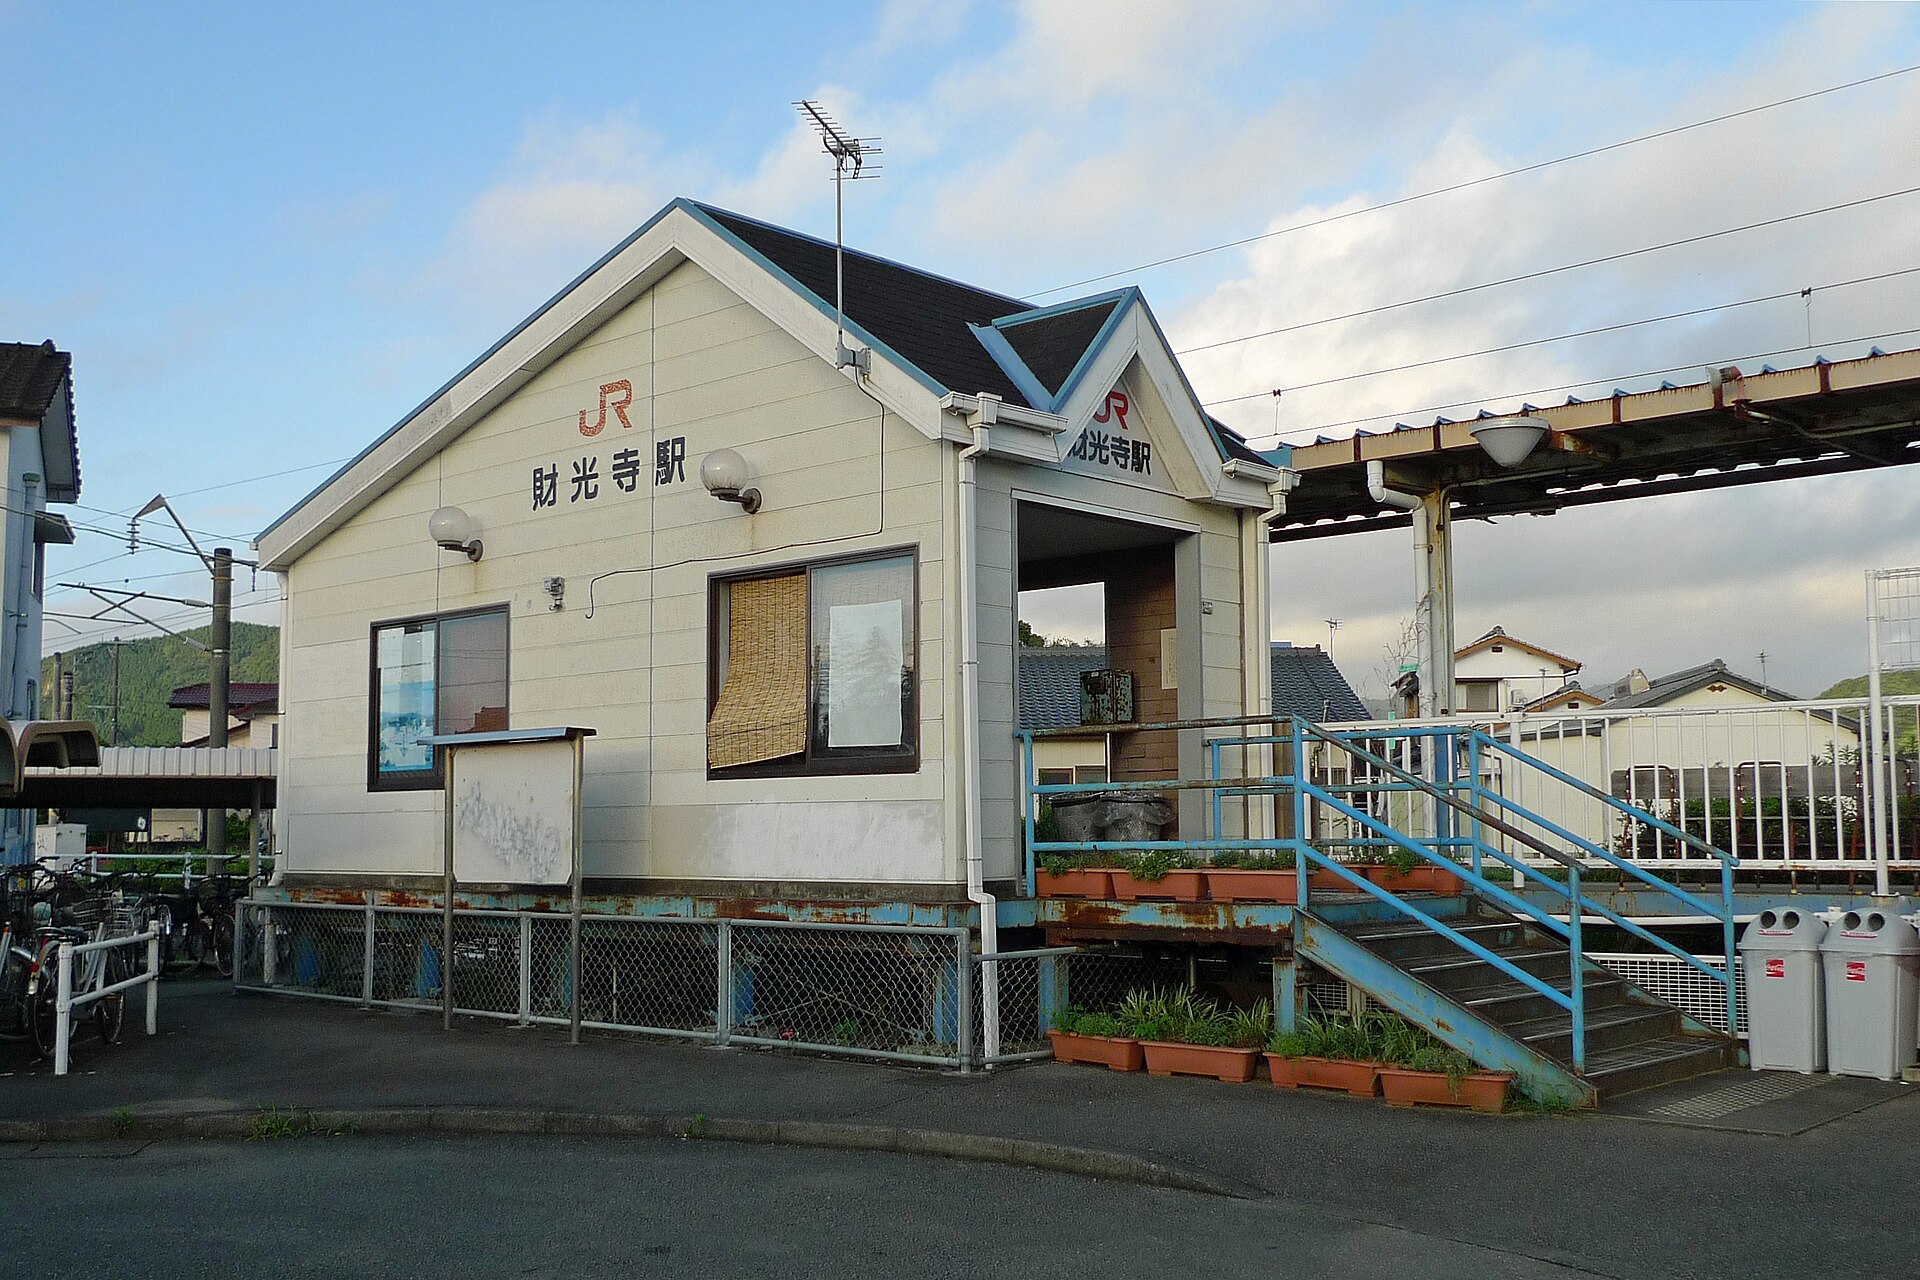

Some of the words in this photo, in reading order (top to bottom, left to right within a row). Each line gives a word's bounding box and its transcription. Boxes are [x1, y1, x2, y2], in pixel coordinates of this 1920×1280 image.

[579, 379, 633, 436] JR
[1093, 390, 1129, 430] JR
[532, 437, 686, 511] 財光寺駅
